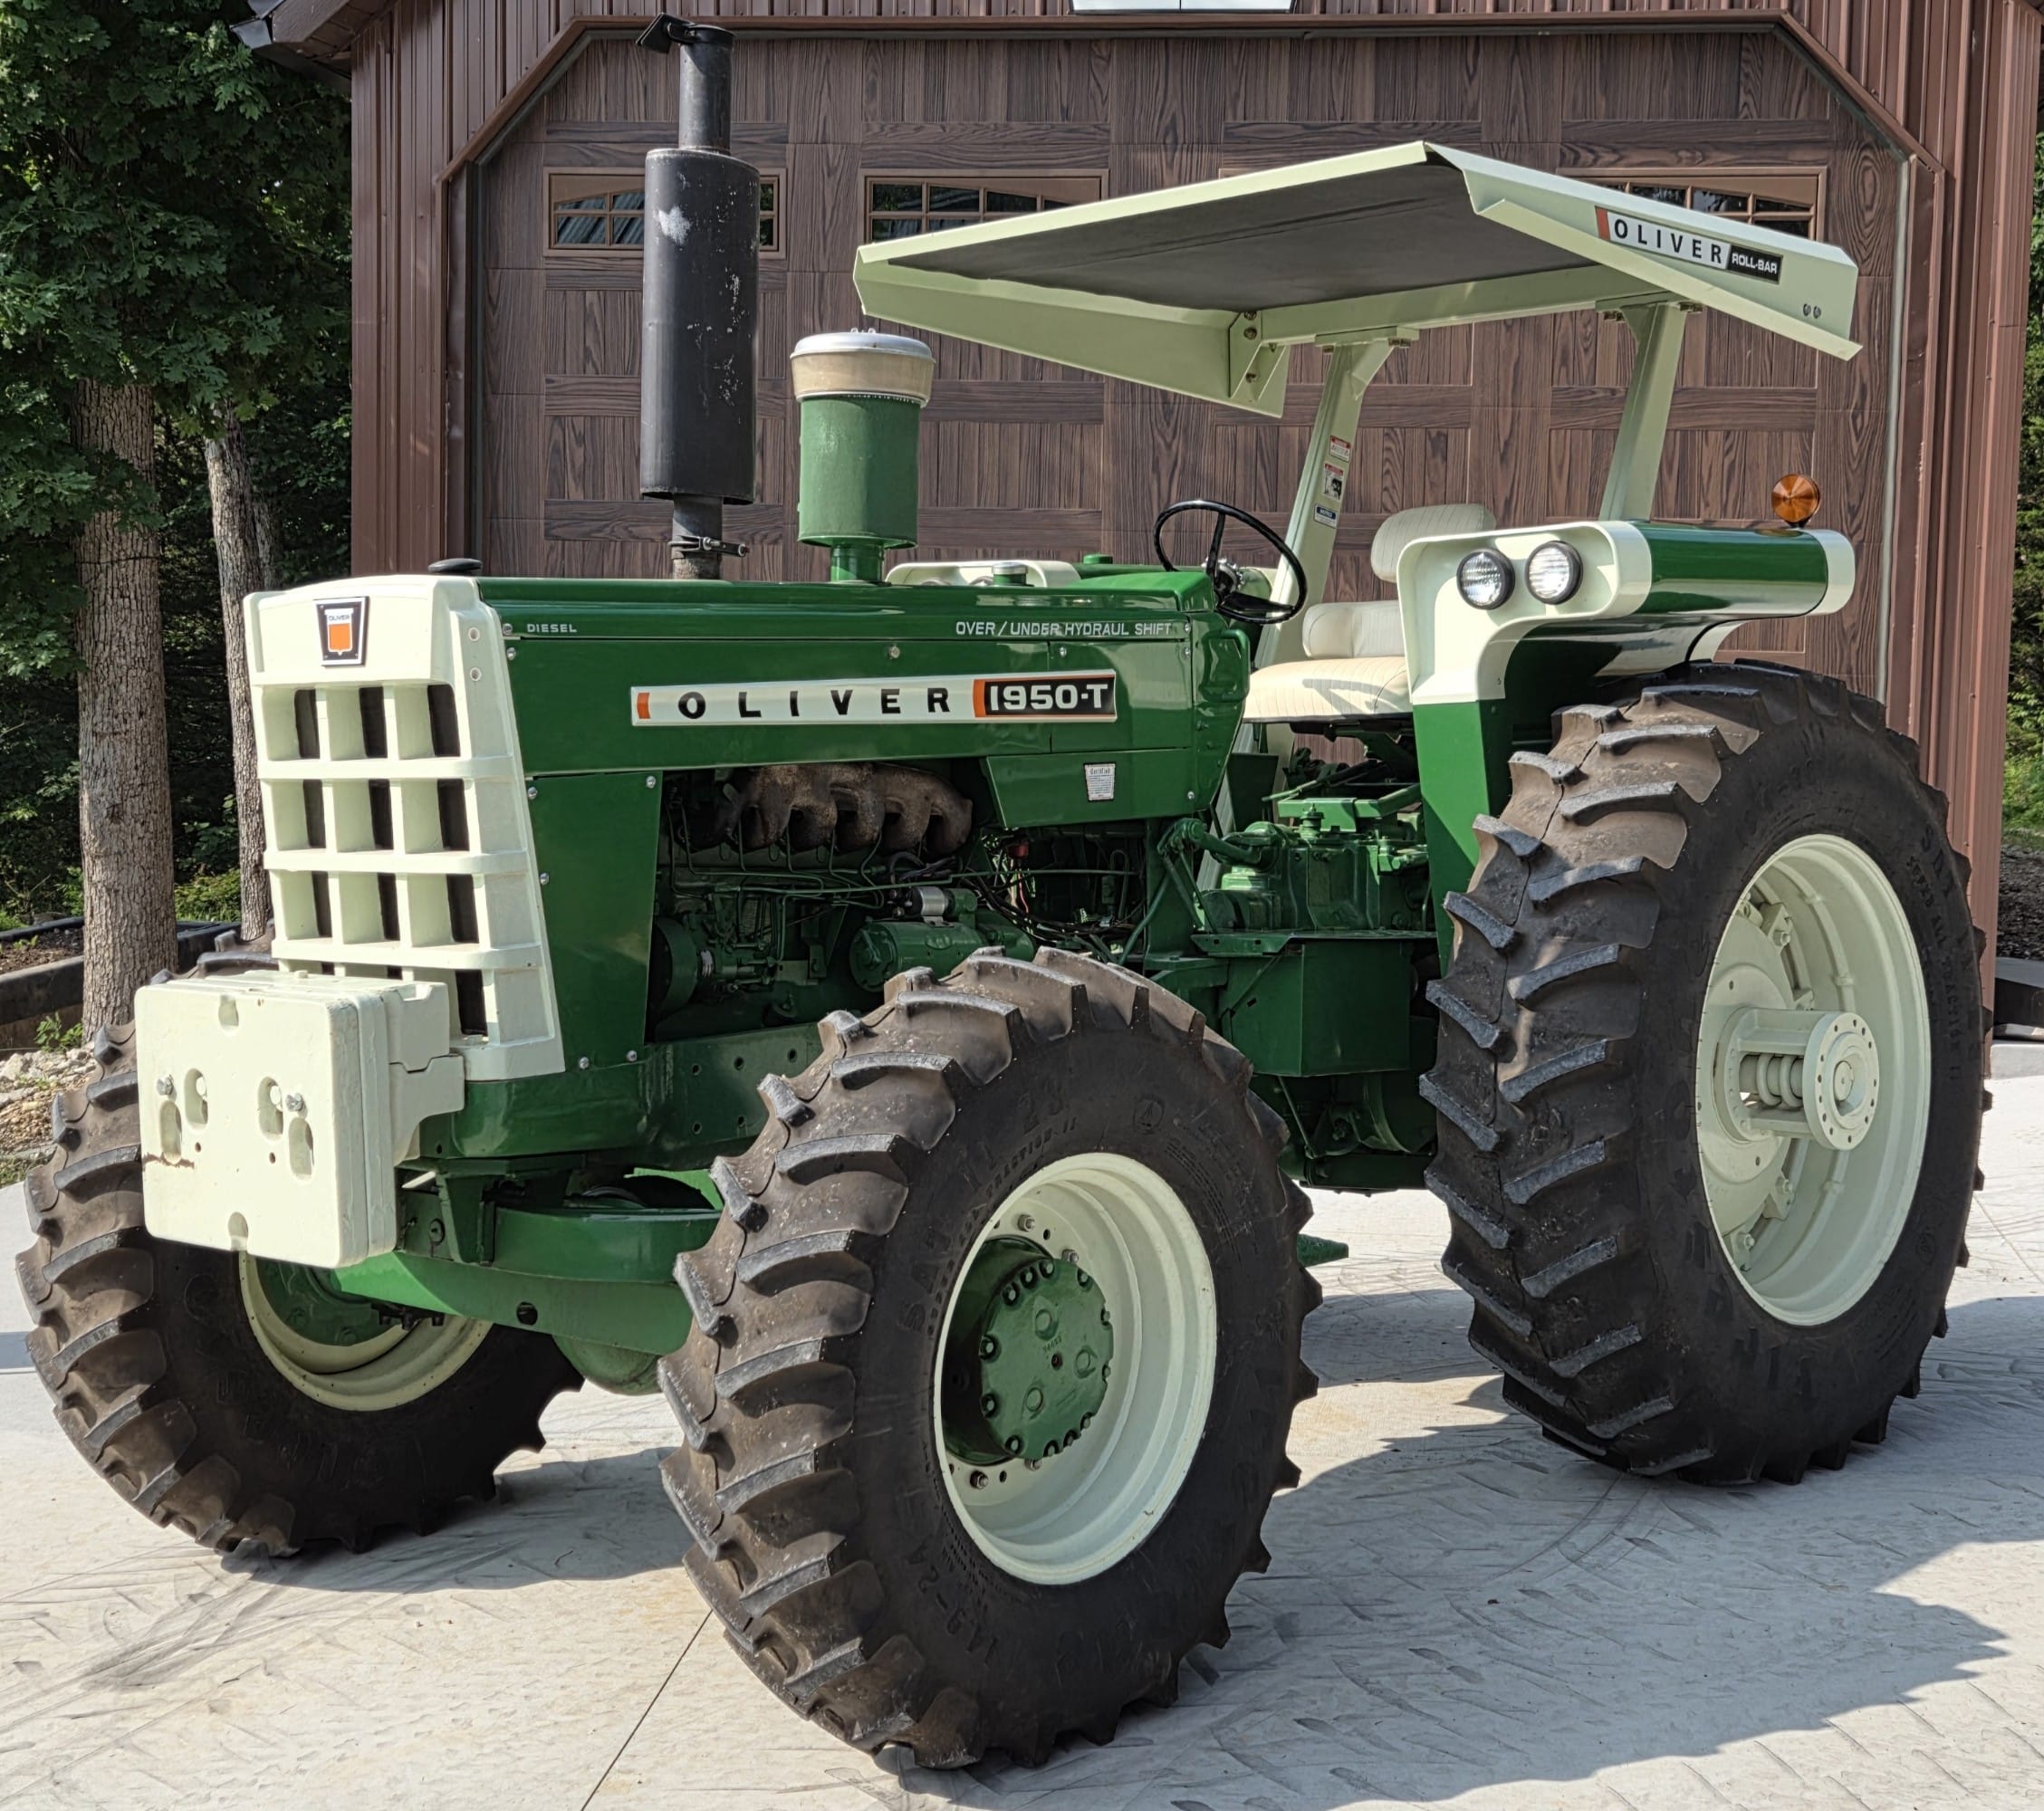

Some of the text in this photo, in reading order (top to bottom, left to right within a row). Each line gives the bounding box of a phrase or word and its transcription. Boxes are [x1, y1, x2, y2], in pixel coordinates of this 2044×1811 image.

[1614, 219, 1777, 274] OLIVER ROLL-BAR
[527, 623, 577, 633] DIESEL
[1065, 621, 1129, 636] HYDRAUL
[1135, 622, 1172, 636] SHIFT
[678, 684, 1109, 719] OLIVER 1950-T
